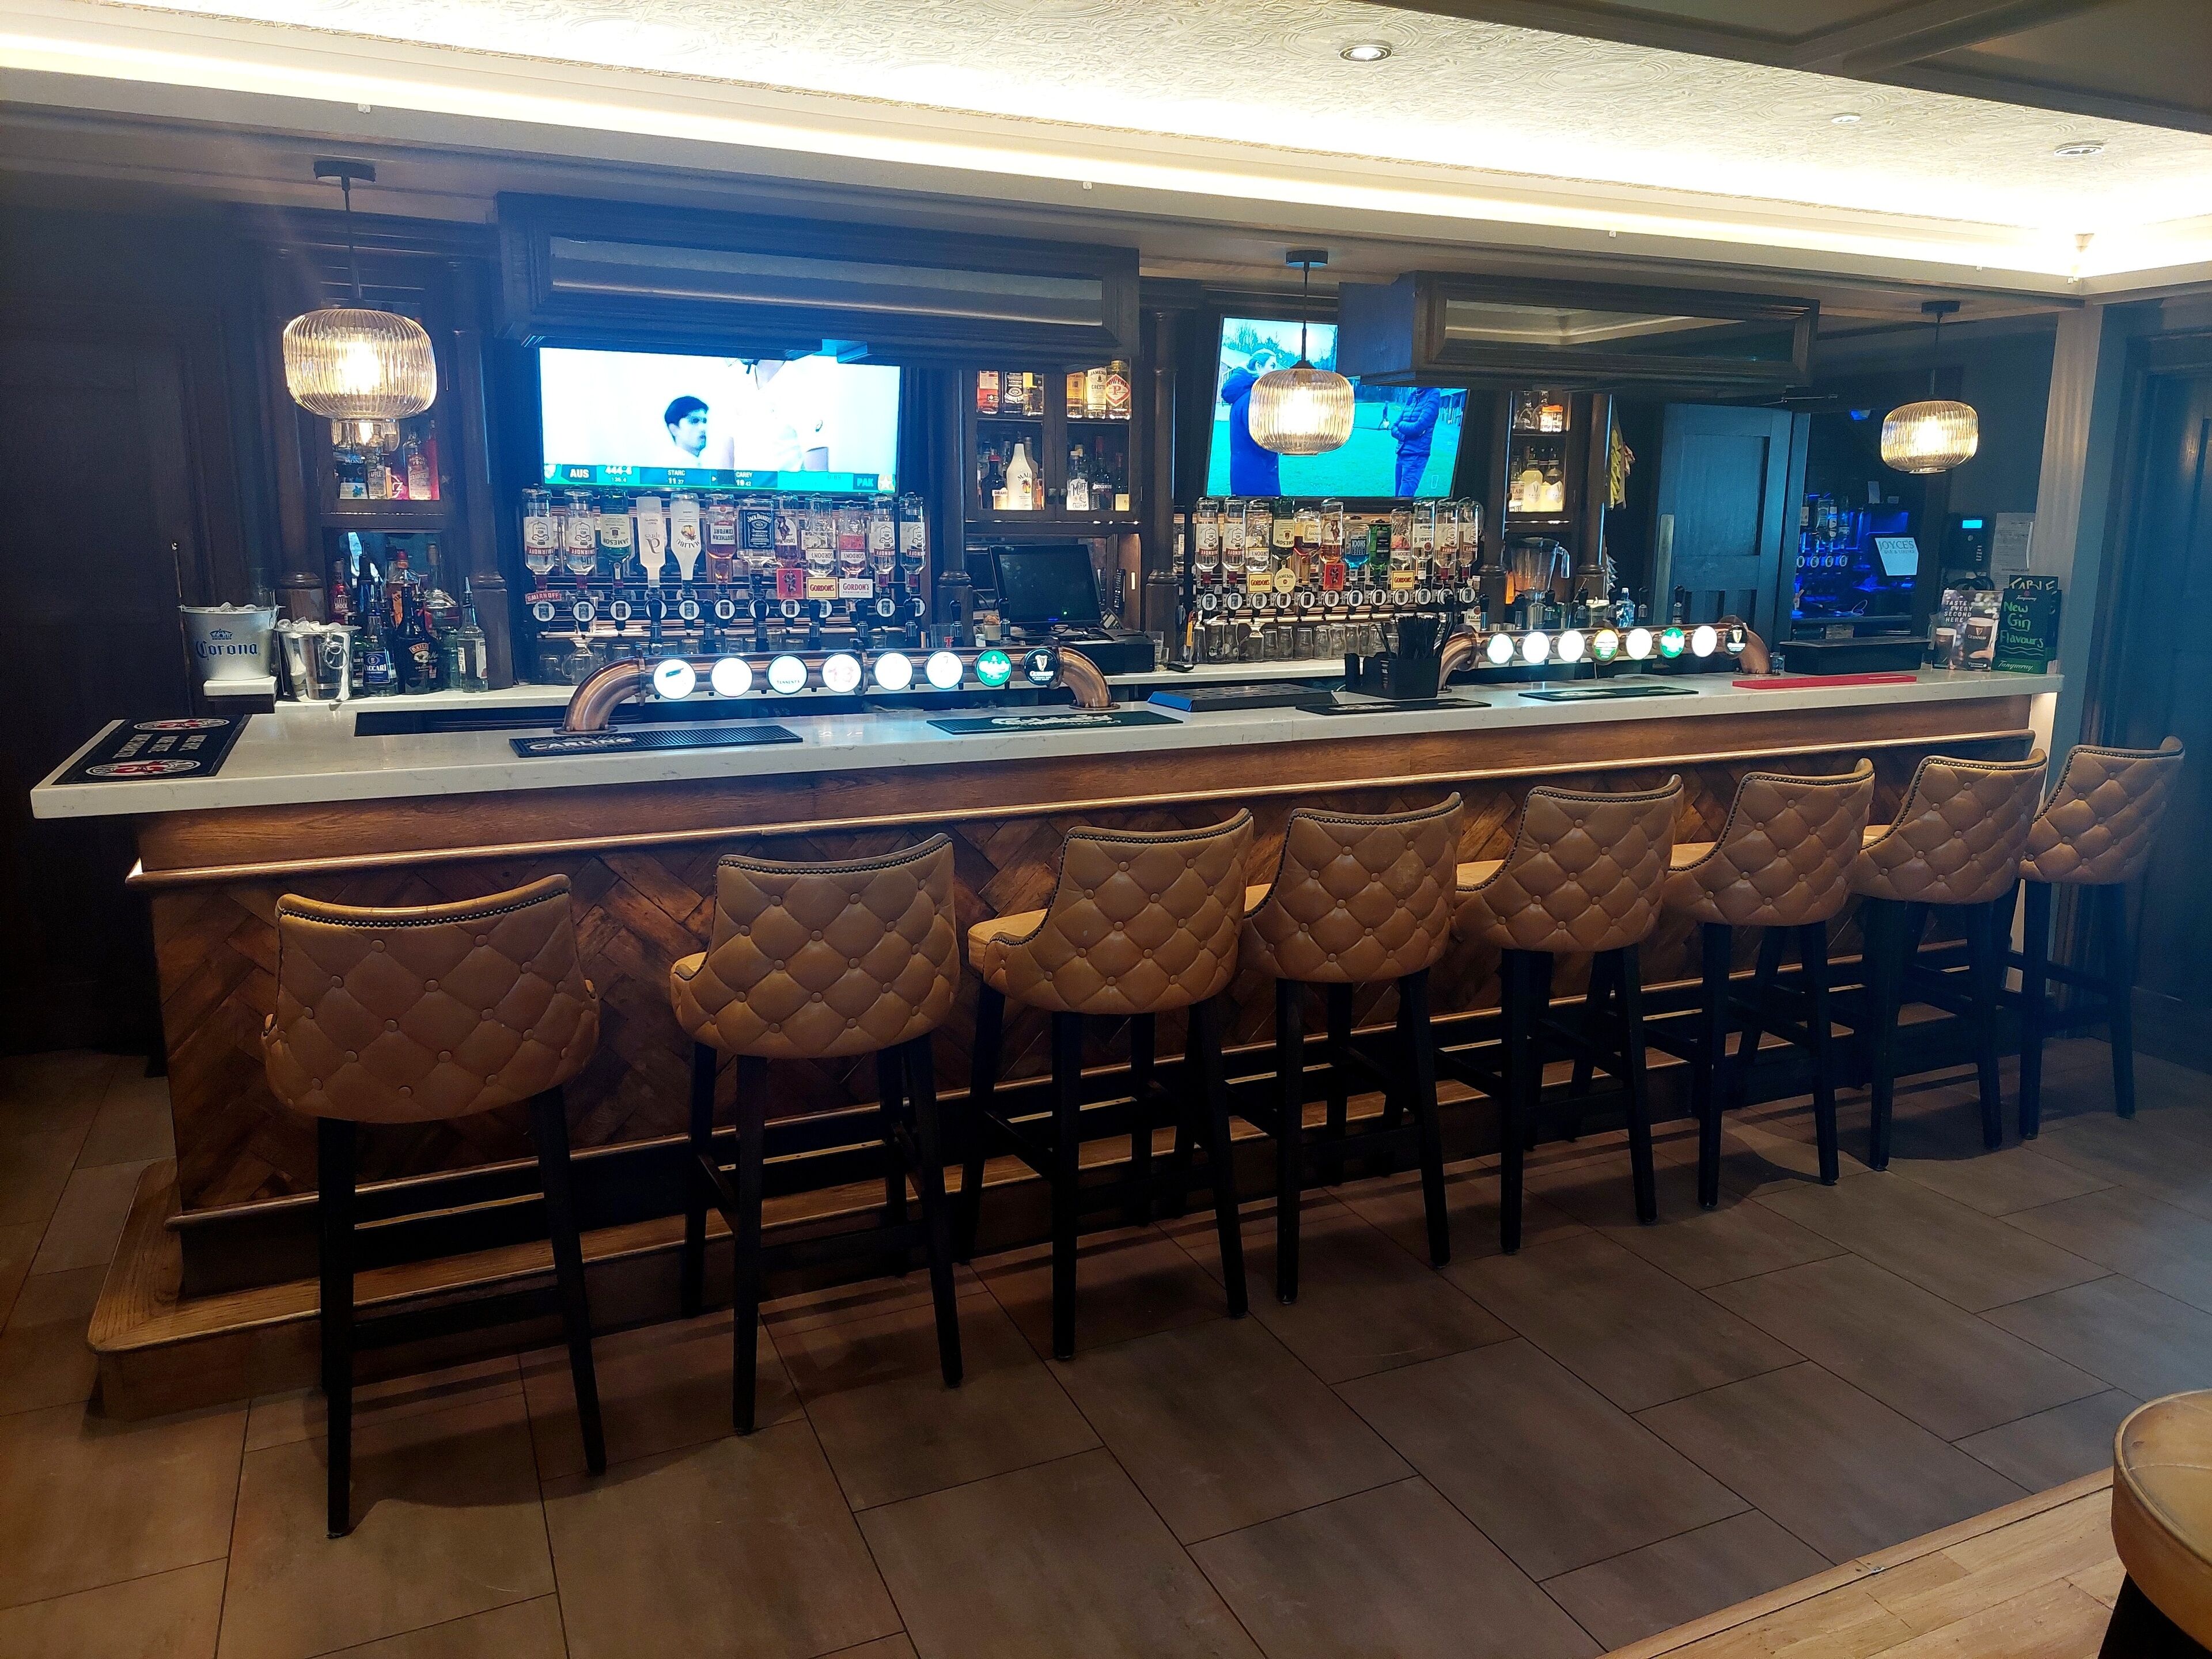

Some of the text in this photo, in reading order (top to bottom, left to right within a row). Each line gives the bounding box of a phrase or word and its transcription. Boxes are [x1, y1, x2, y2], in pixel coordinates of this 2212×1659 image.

[1113, 385, 1122, 395] P
[570, 468, 589, 478] AUS
[856, 478, 874, 487] PAK
[747, 514, 757, 523] JACK
[603, 537, 630, 546] JAMESON
[676, 539, 700, 548] MALIBU
[1351, 540, 1366, 548] SHOCK
[1878, 540, 1914, 551] JOYCE'S
[1351, 547, 1366, 555] AFTER
[843, 583, 870, 591] GORDON'S
[2003, 601, 2028, 613] New
[2007, 613, 2032, 630] Gin
[2000, 630, 2044, 648] Flavours
[196, 640, 257, 661] Corona
[529, 738, 633, 750] CARLING
